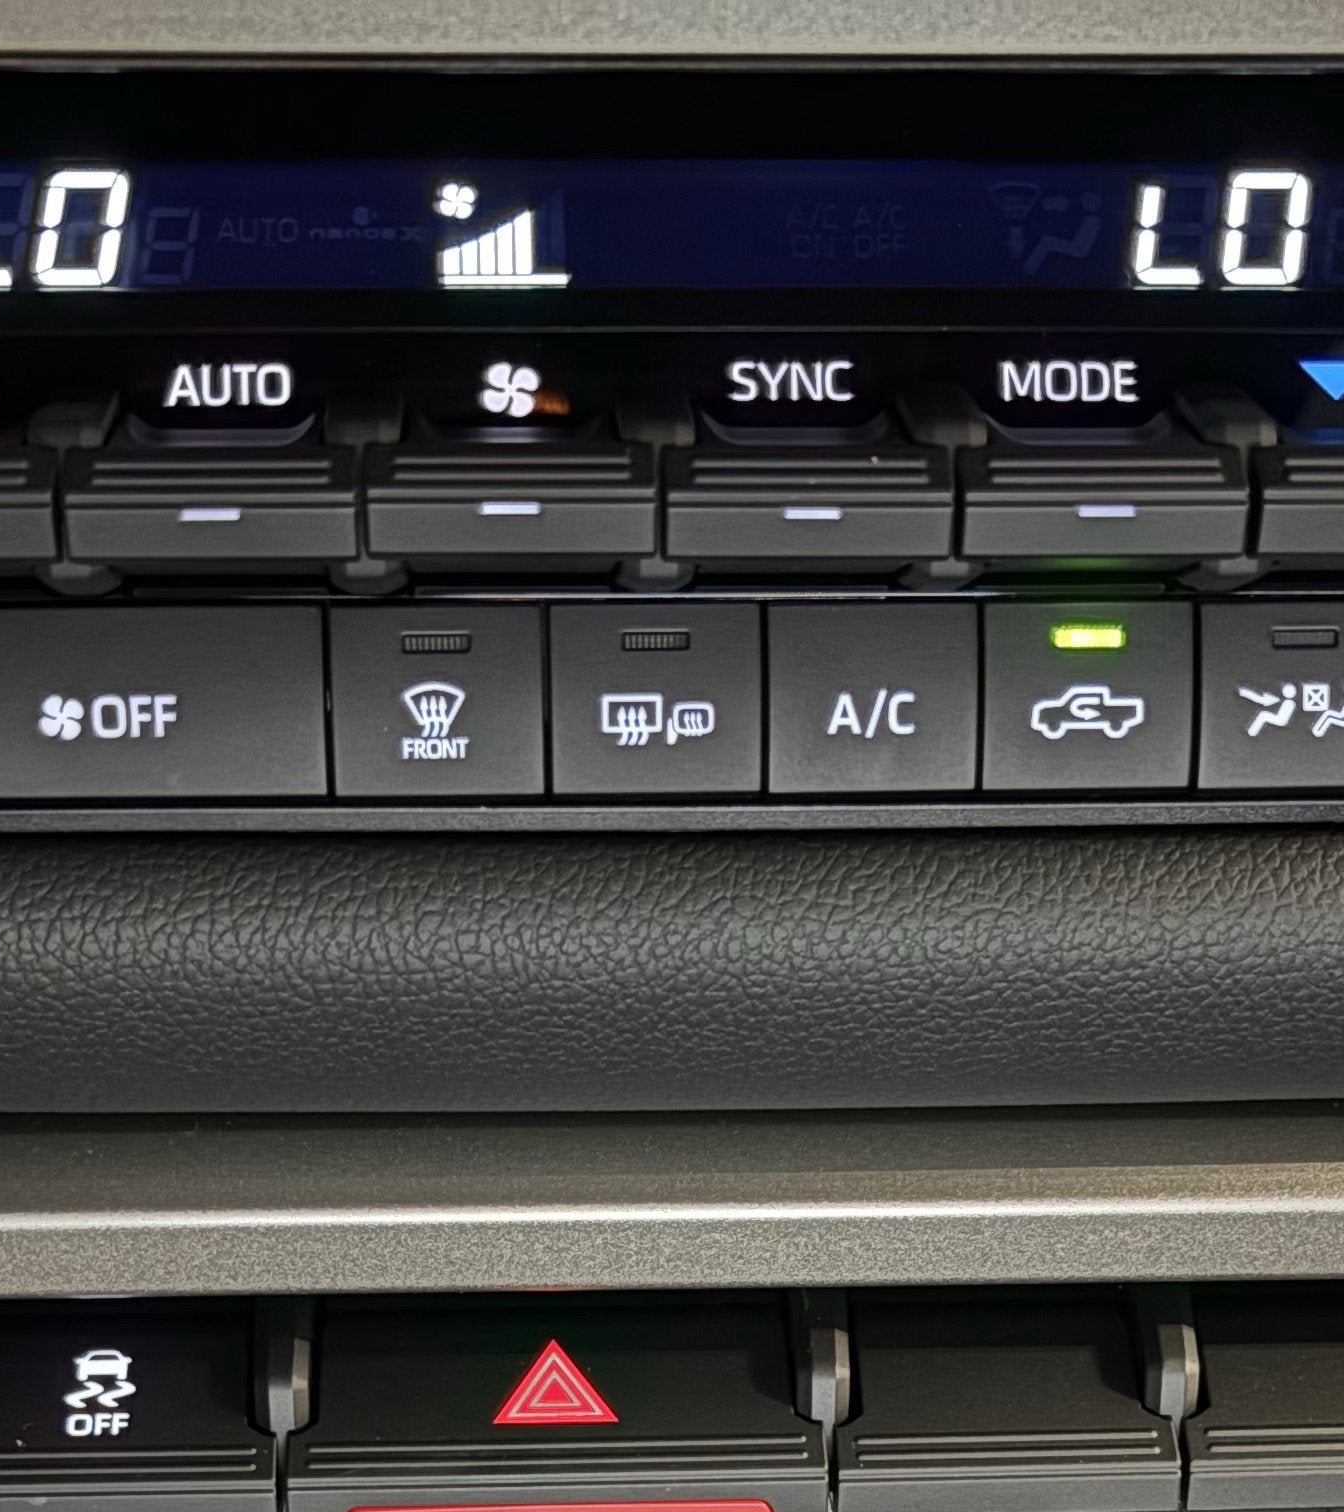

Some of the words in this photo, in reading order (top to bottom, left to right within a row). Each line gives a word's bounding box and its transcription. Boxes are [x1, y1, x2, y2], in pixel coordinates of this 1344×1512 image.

[1132, 170, 1311, 287] LO
[164, 362, 292, 407] AUTO
[728, 360, 854, 403] SYNC
[1000, 360, 1138, 403] MODE
[89, 693, 178, 740] OFF
[827, 689, 916, 740] A/C
[401, 736, 469, 761] FRONT
[65, 1412, 130, 1437] OFF
